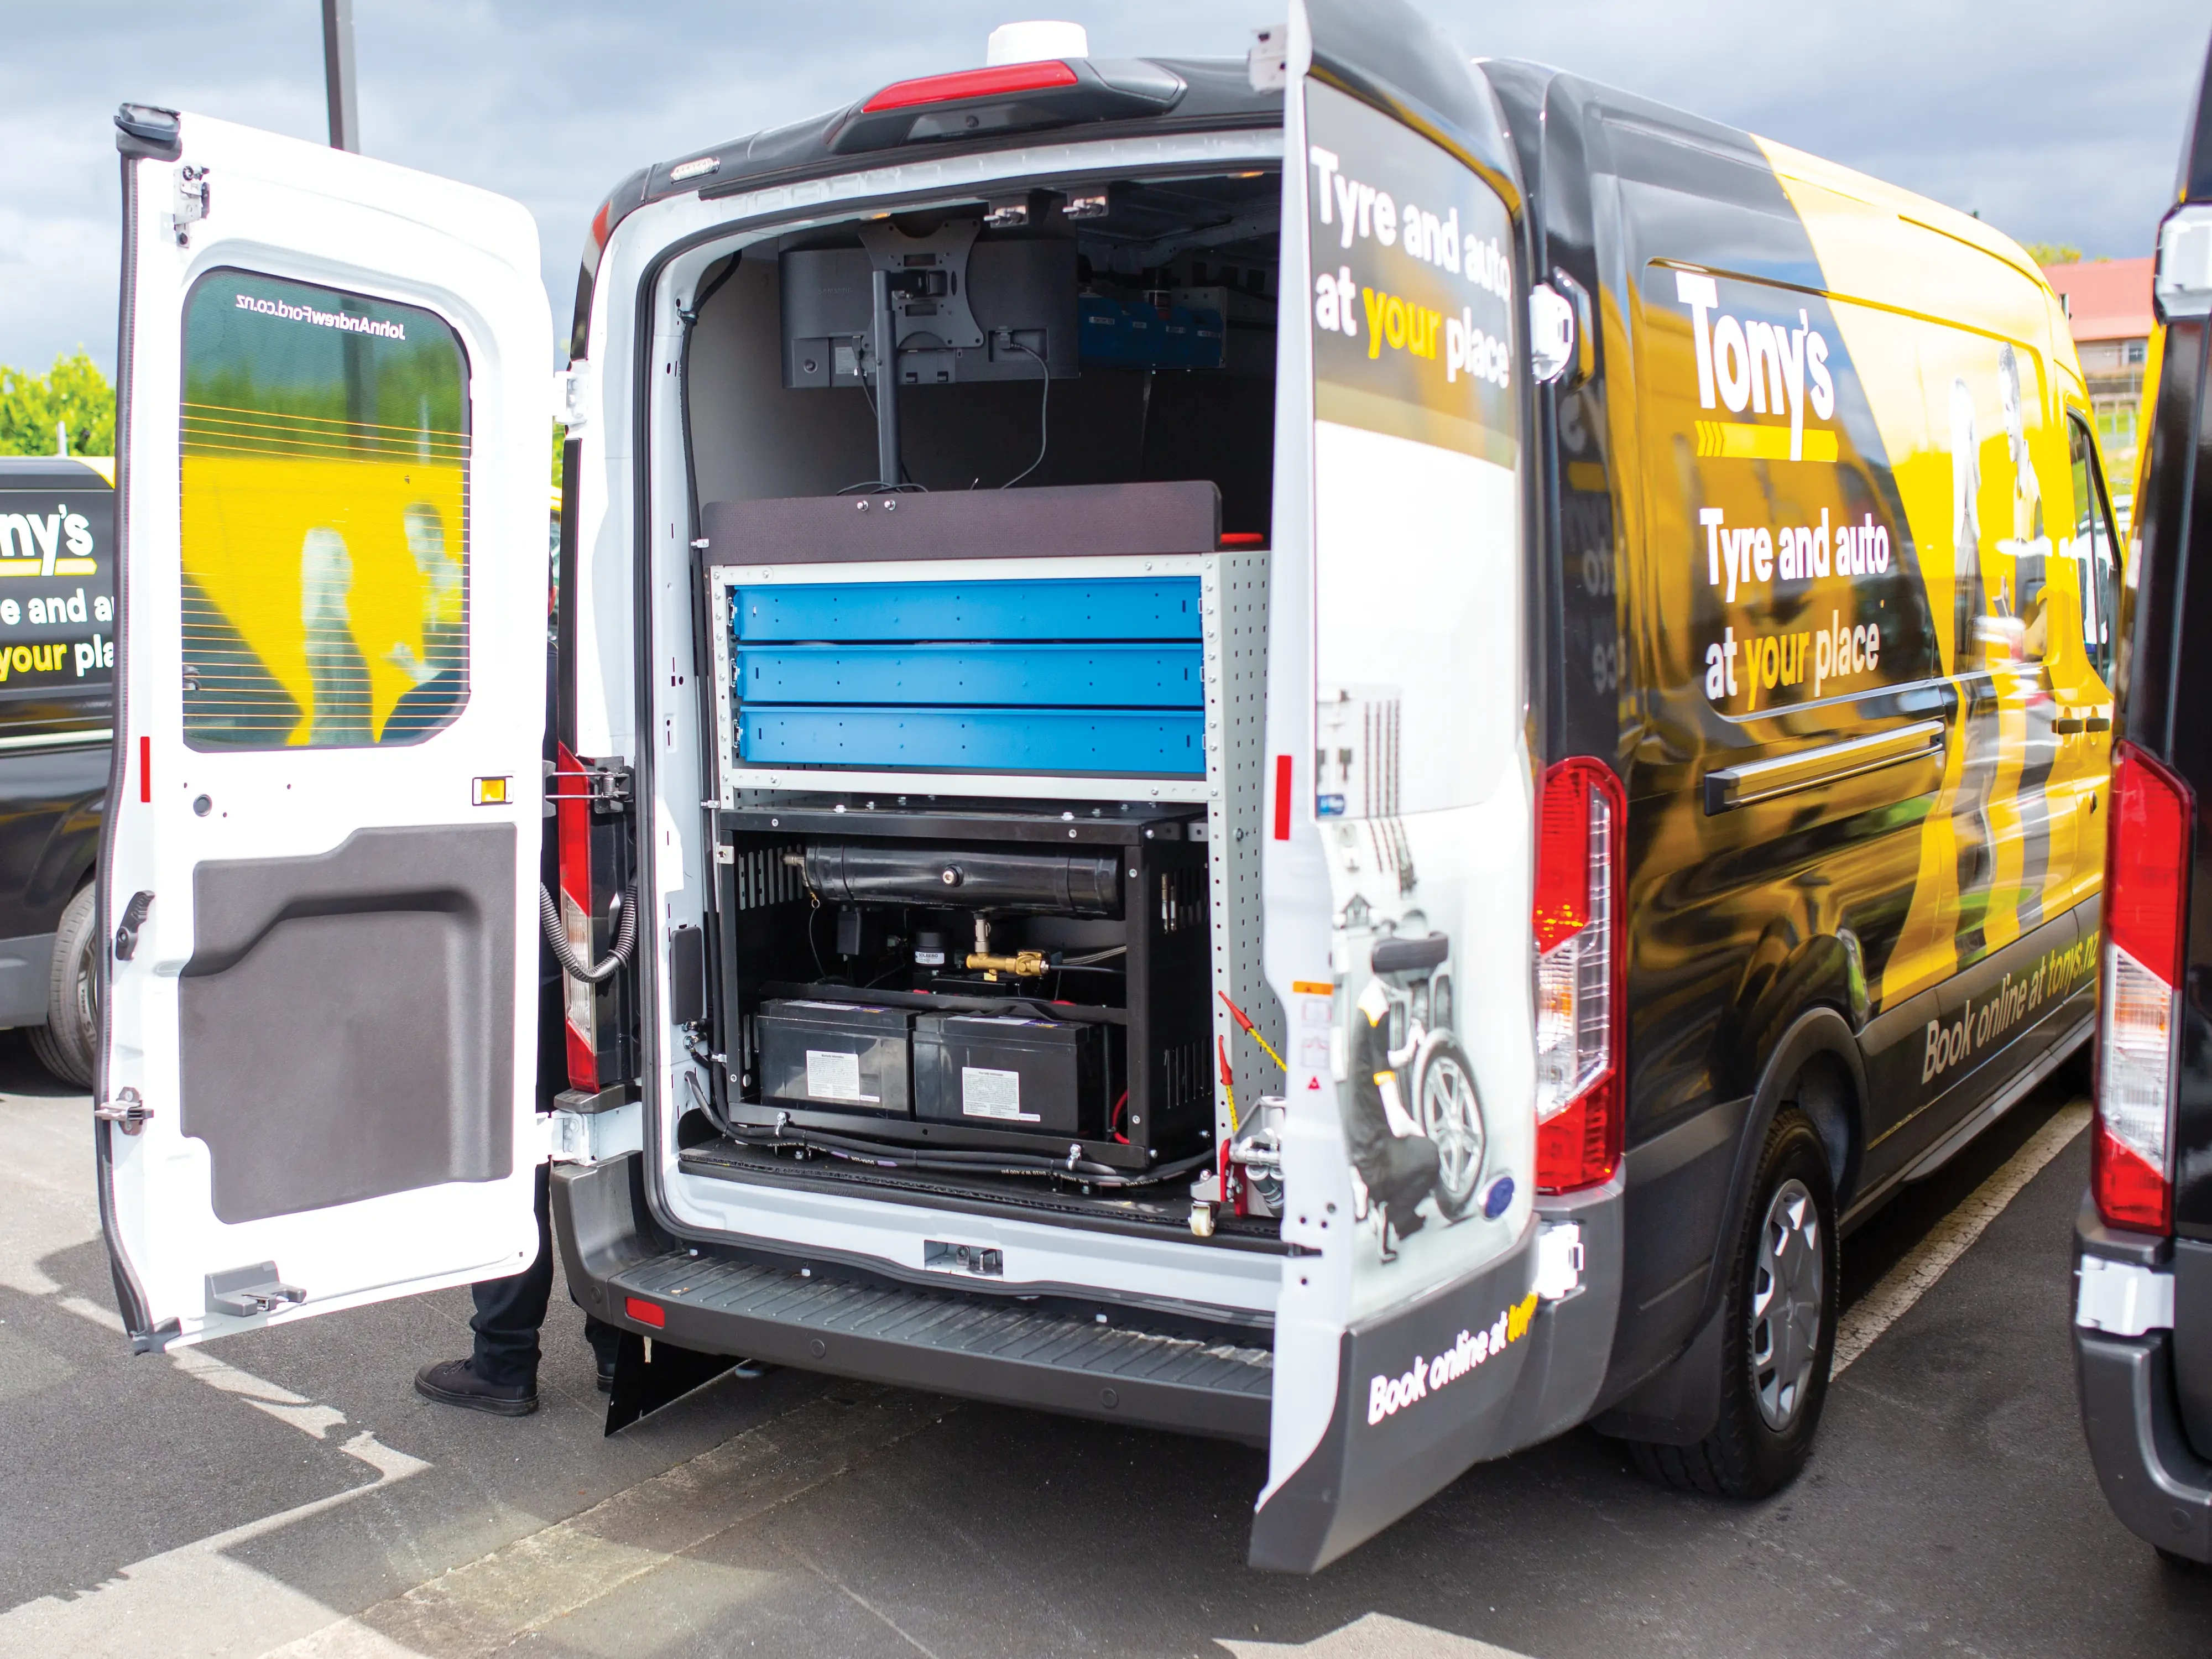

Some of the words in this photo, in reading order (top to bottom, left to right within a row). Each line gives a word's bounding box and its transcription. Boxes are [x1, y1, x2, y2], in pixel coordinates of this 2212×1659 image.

[1310, 145, 1397, 249] Tyre
[1402, 204, 1460, 274] and
[1463, 233, 1512, 302] auto
[1315, 265, 1357, 337] at
[1362, 286, 1442, 362] your
[1445, 306, 1510, 389] place
[1675, 271, 1835, 462] Tony's
[28, 588, 87, 624] and
[1699, 508, 1773, 603] Tyre
[1778, 507, 1830, 580] and
[1835, 512, 1890, 576] auto
[0, 645, 67, 682] your
[1705, 627, 1738, 701] at
[1746, 631, 1811, 712] your
[1814, 609, 1881, 698] place
[1922, 999, 1976, 1085] Book
[1976, 972, 2027, 1049] online
[2028, 955, 2047, 1012] at
[2047, 929, 2100, 999] tonys.nz
[1368, 1355, 1429, 1426] Book
[1429, 1329, 1489, 1390] online
[1488, 1310, 1508, 1355] at
